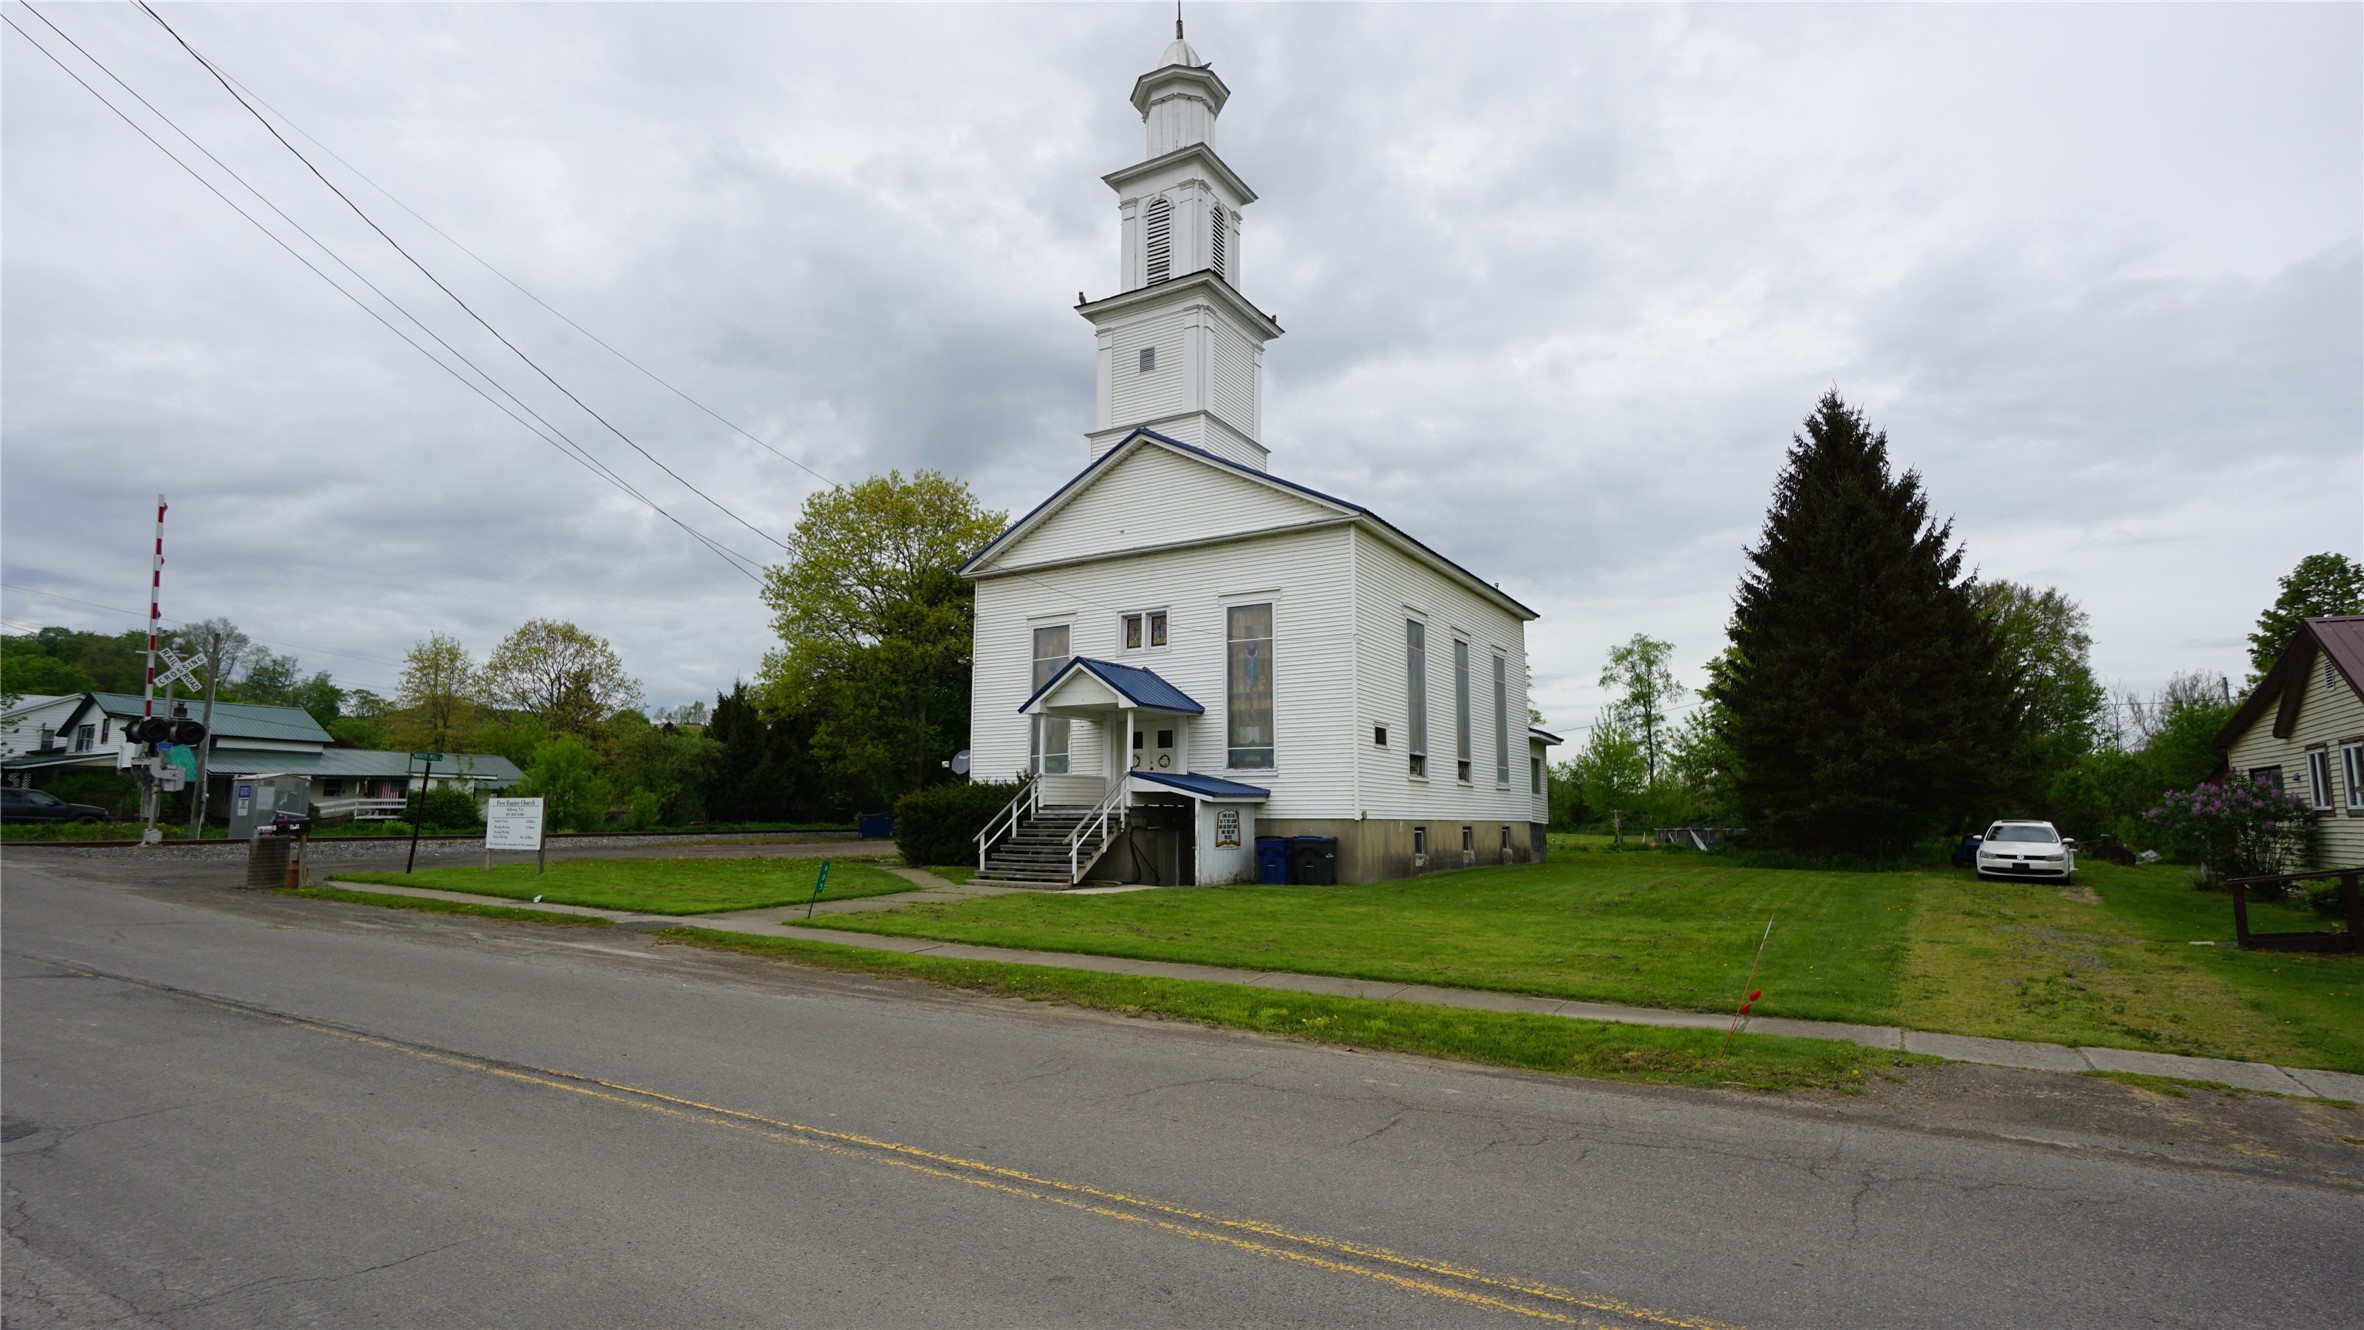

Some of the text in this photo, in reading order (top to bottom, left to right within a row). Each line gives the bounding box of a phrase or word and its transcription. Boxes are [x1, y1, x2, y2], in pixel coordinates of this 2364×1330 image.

[158, 655, 204, 685] CROSSING
[161, 649, 200, 691] RAIL ROAD
